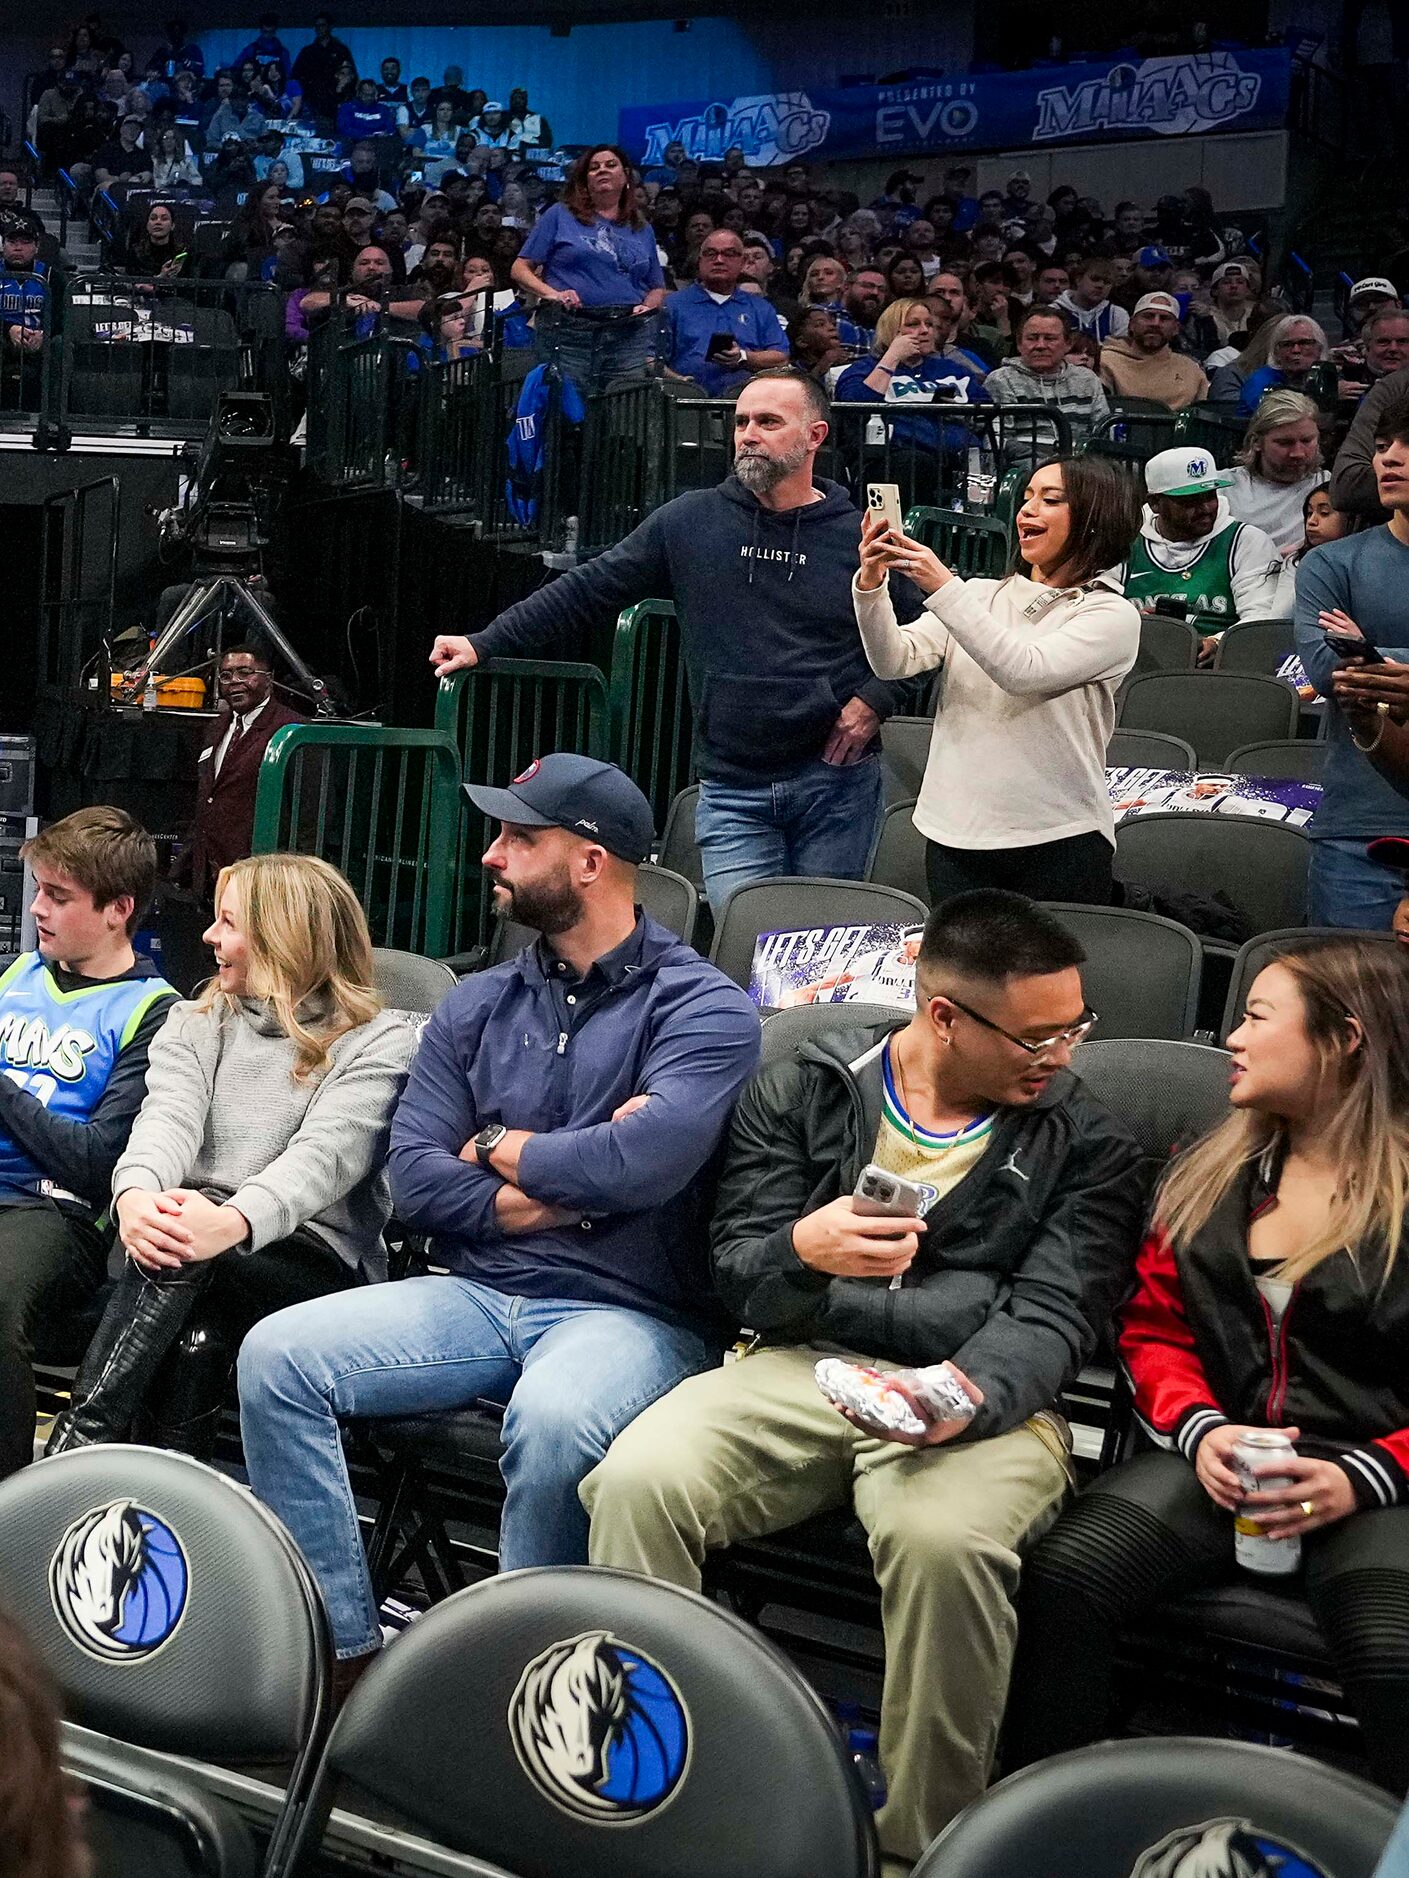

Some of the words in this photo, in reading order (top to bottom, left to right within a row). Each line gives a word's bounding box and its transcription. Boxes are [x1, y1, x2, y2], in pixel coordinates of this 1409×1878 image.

[876, 99, 979, 142] EVO
[756, 929, 825, 974] LET'S
[820, 926, 873, 964] GET
